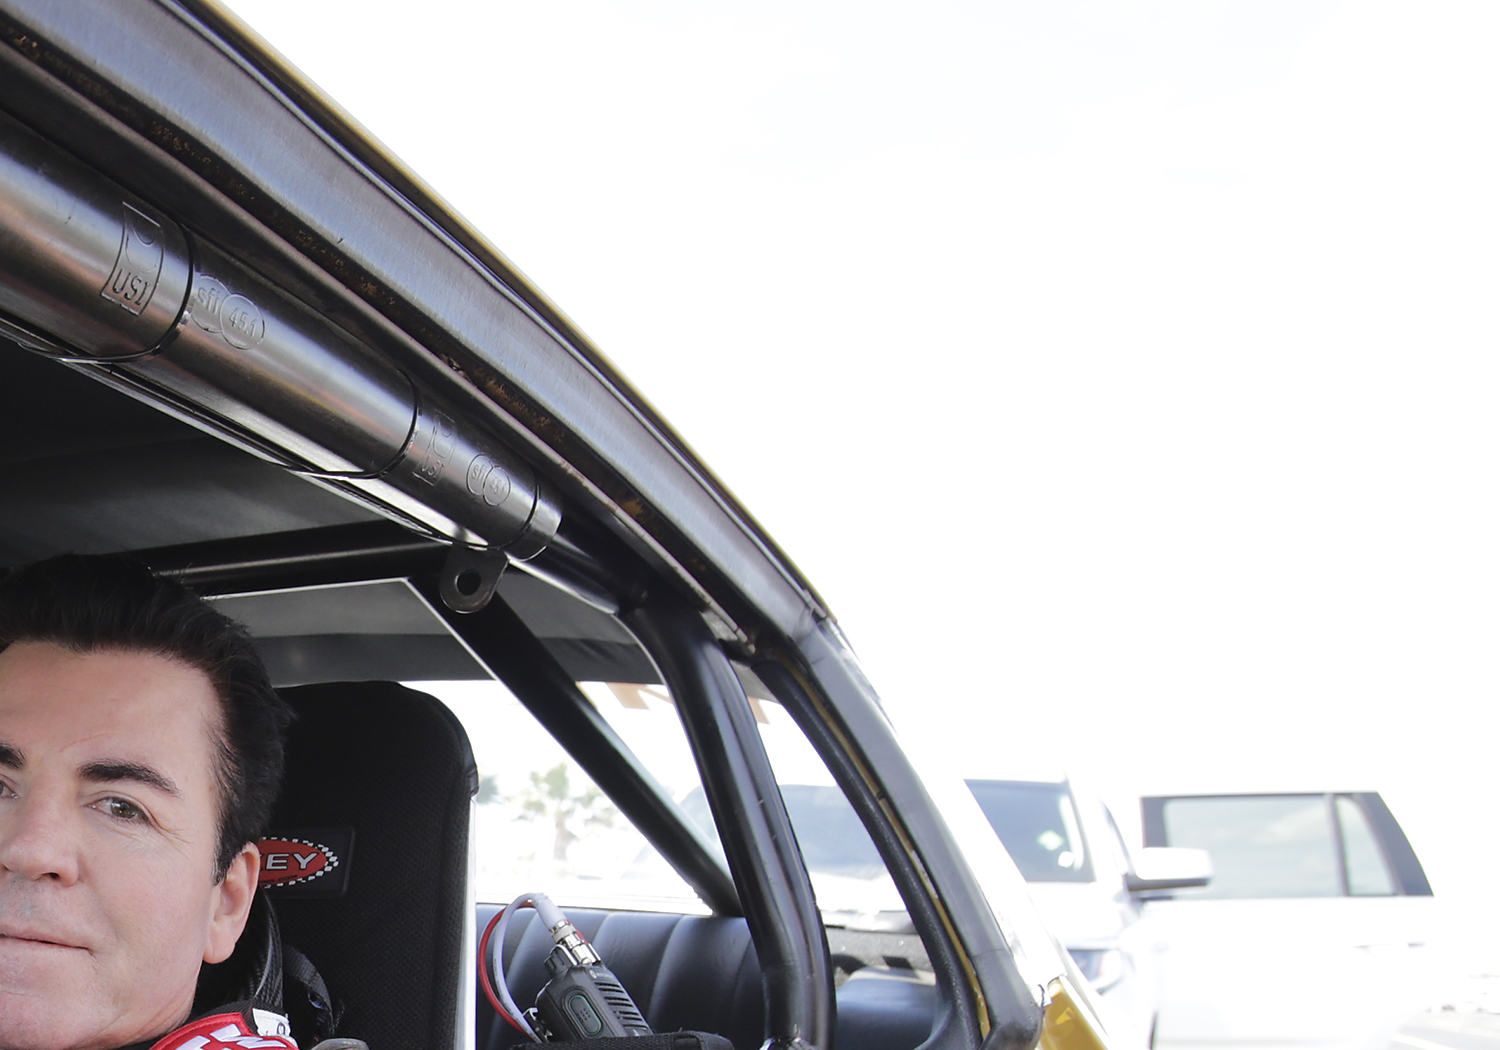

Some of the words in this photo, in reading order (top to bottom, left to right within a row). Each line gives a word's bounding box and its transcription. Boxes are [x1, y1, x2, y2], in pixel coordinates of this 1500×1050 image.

[112, 269, 149, 305] USI
[197, 287, 221, 315] sfi
[229, 307, 257, 337] 45.1
[260, 852, 319, 870] EY
